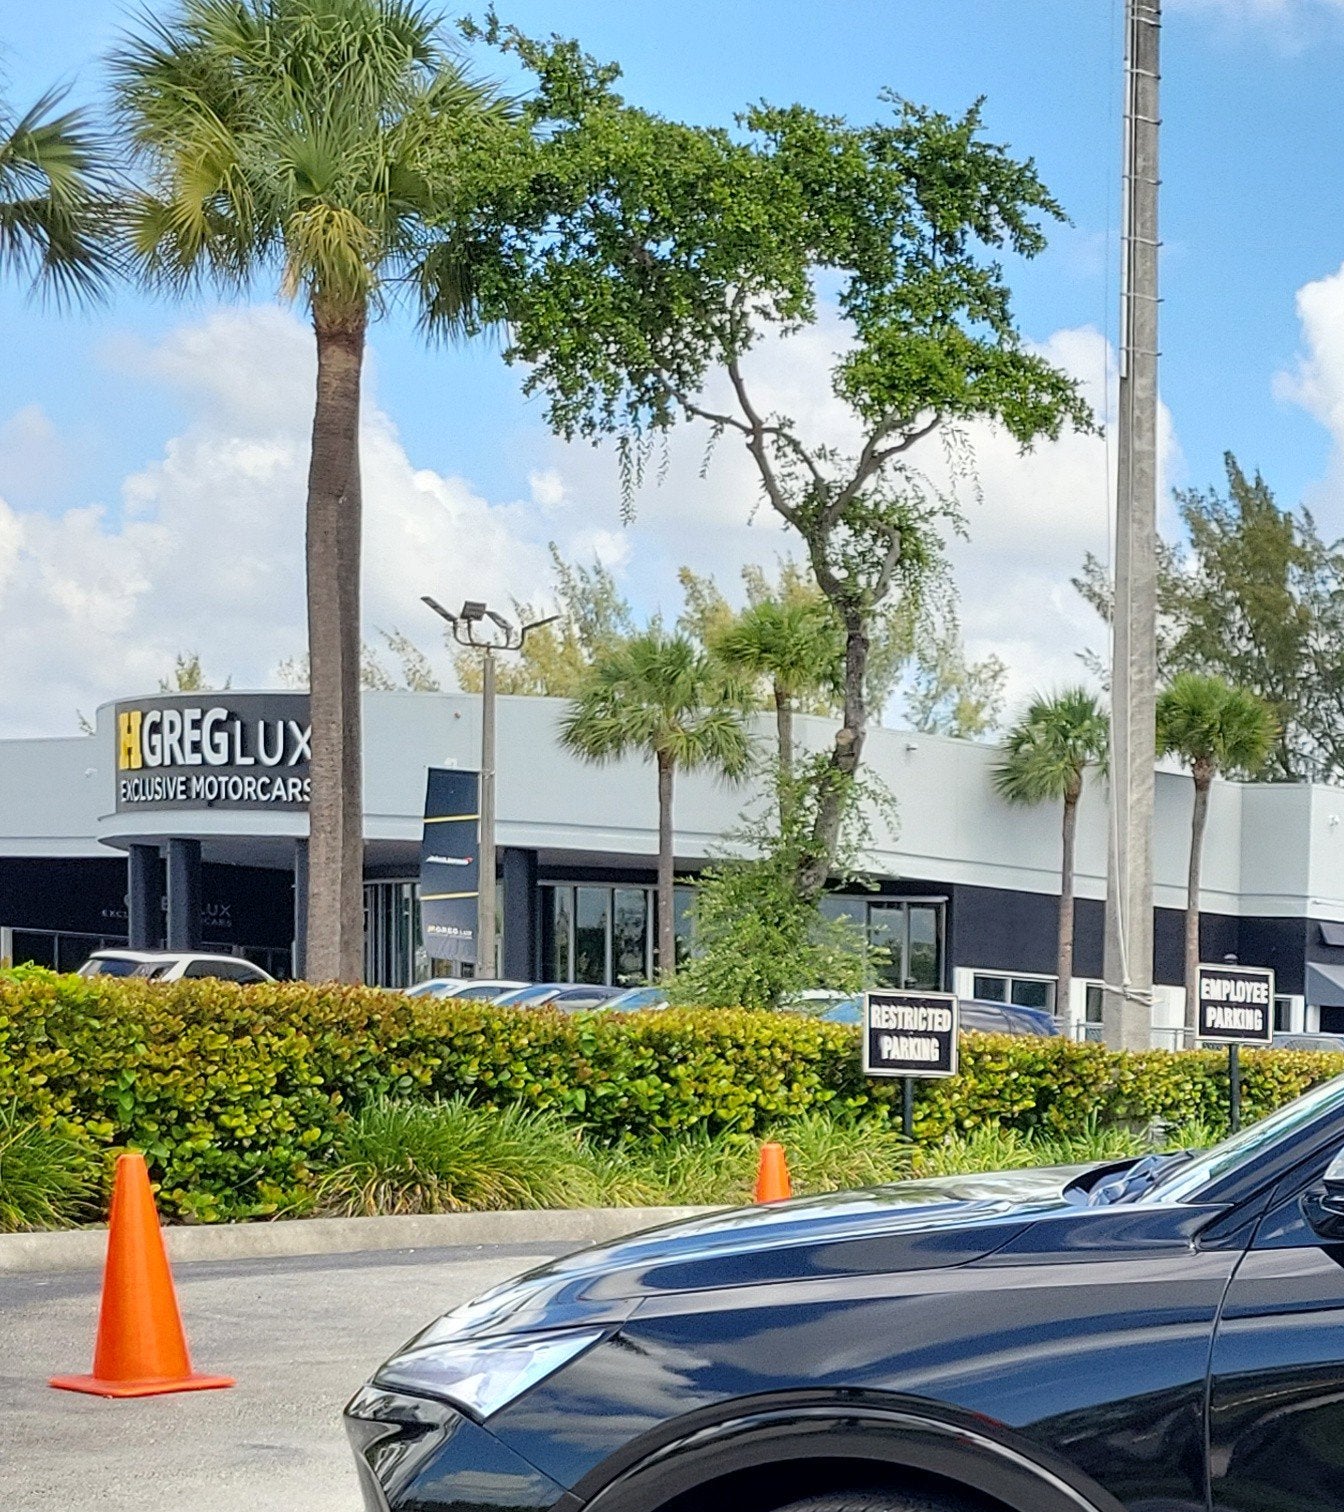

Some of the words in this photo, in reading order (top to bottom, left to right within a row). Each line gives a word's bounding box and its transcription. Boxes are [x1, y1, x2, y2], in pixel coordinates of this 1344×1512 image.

[121, 776, 187, 802] EXCLUSIVE
[192, 775, 311, 802] MOTORCARS
[1201, 977, 1269, 1004] EMPLOYEE
[871, 1004, 952, 1032] RESTRICTED
[1206, 1006, 1263, 1031] PARKING
[880, 1035, 940, 1062] PARKING
